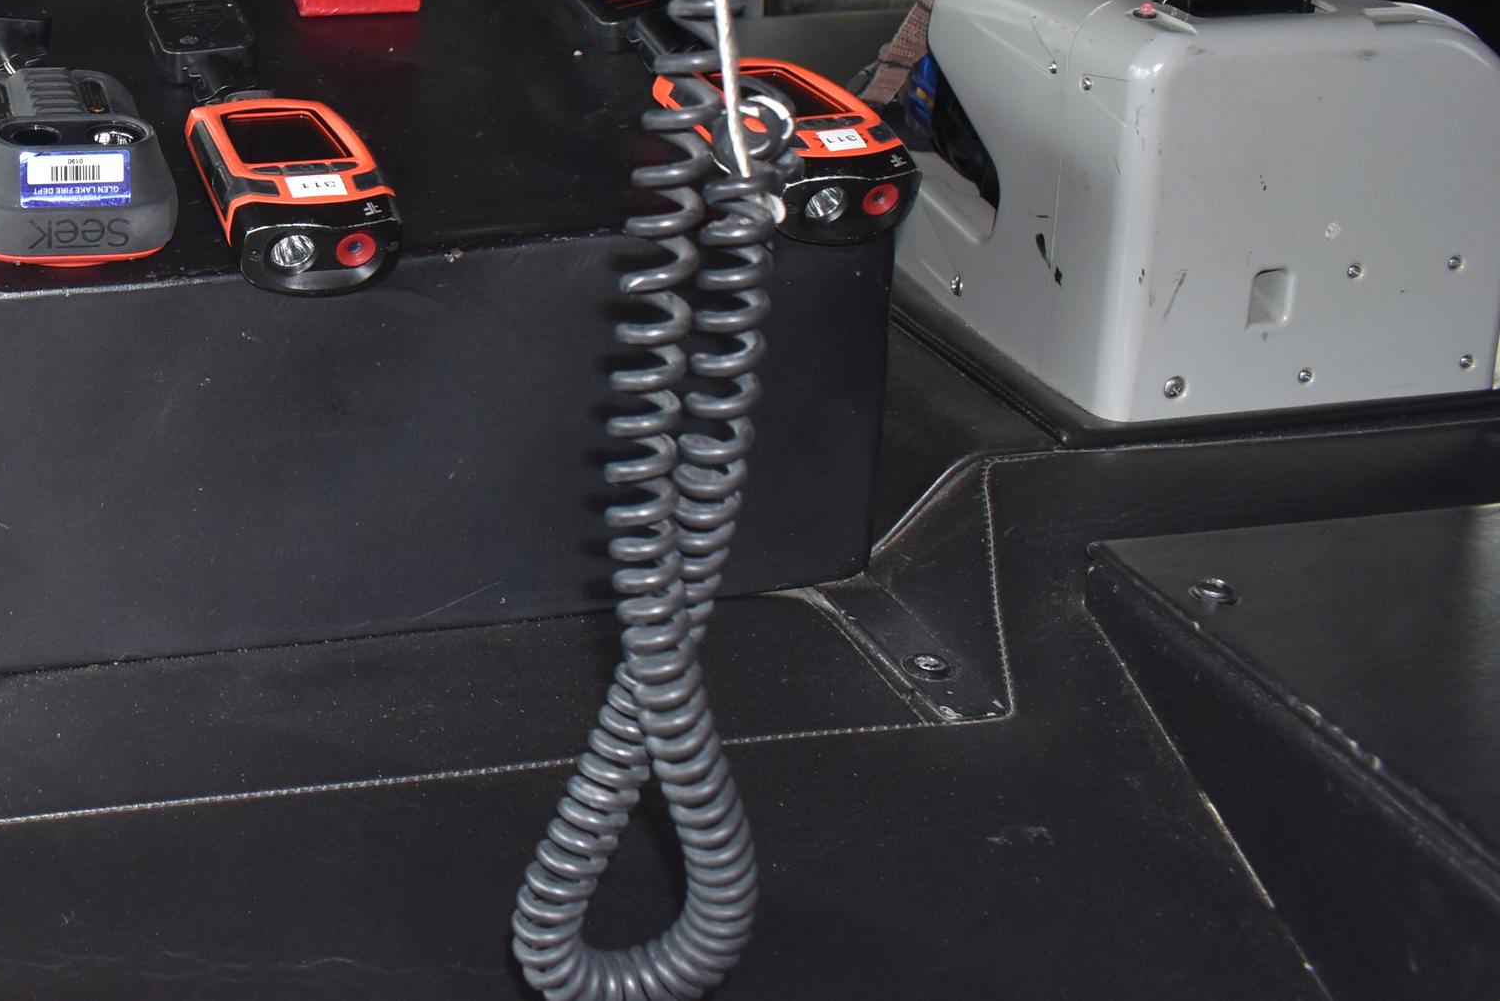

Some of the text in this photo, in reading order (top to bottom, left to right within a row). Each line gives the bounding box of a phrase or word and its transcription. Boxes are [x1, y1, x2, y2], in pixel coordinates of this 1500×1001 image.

[826, 134, 858, 144] 311
[302, 180, 337, 189] 311
[33, 187, 55, 195] DEPT
[75, 186, 96, 194] LAKE
[97, 185, 120, 193] GLEN
